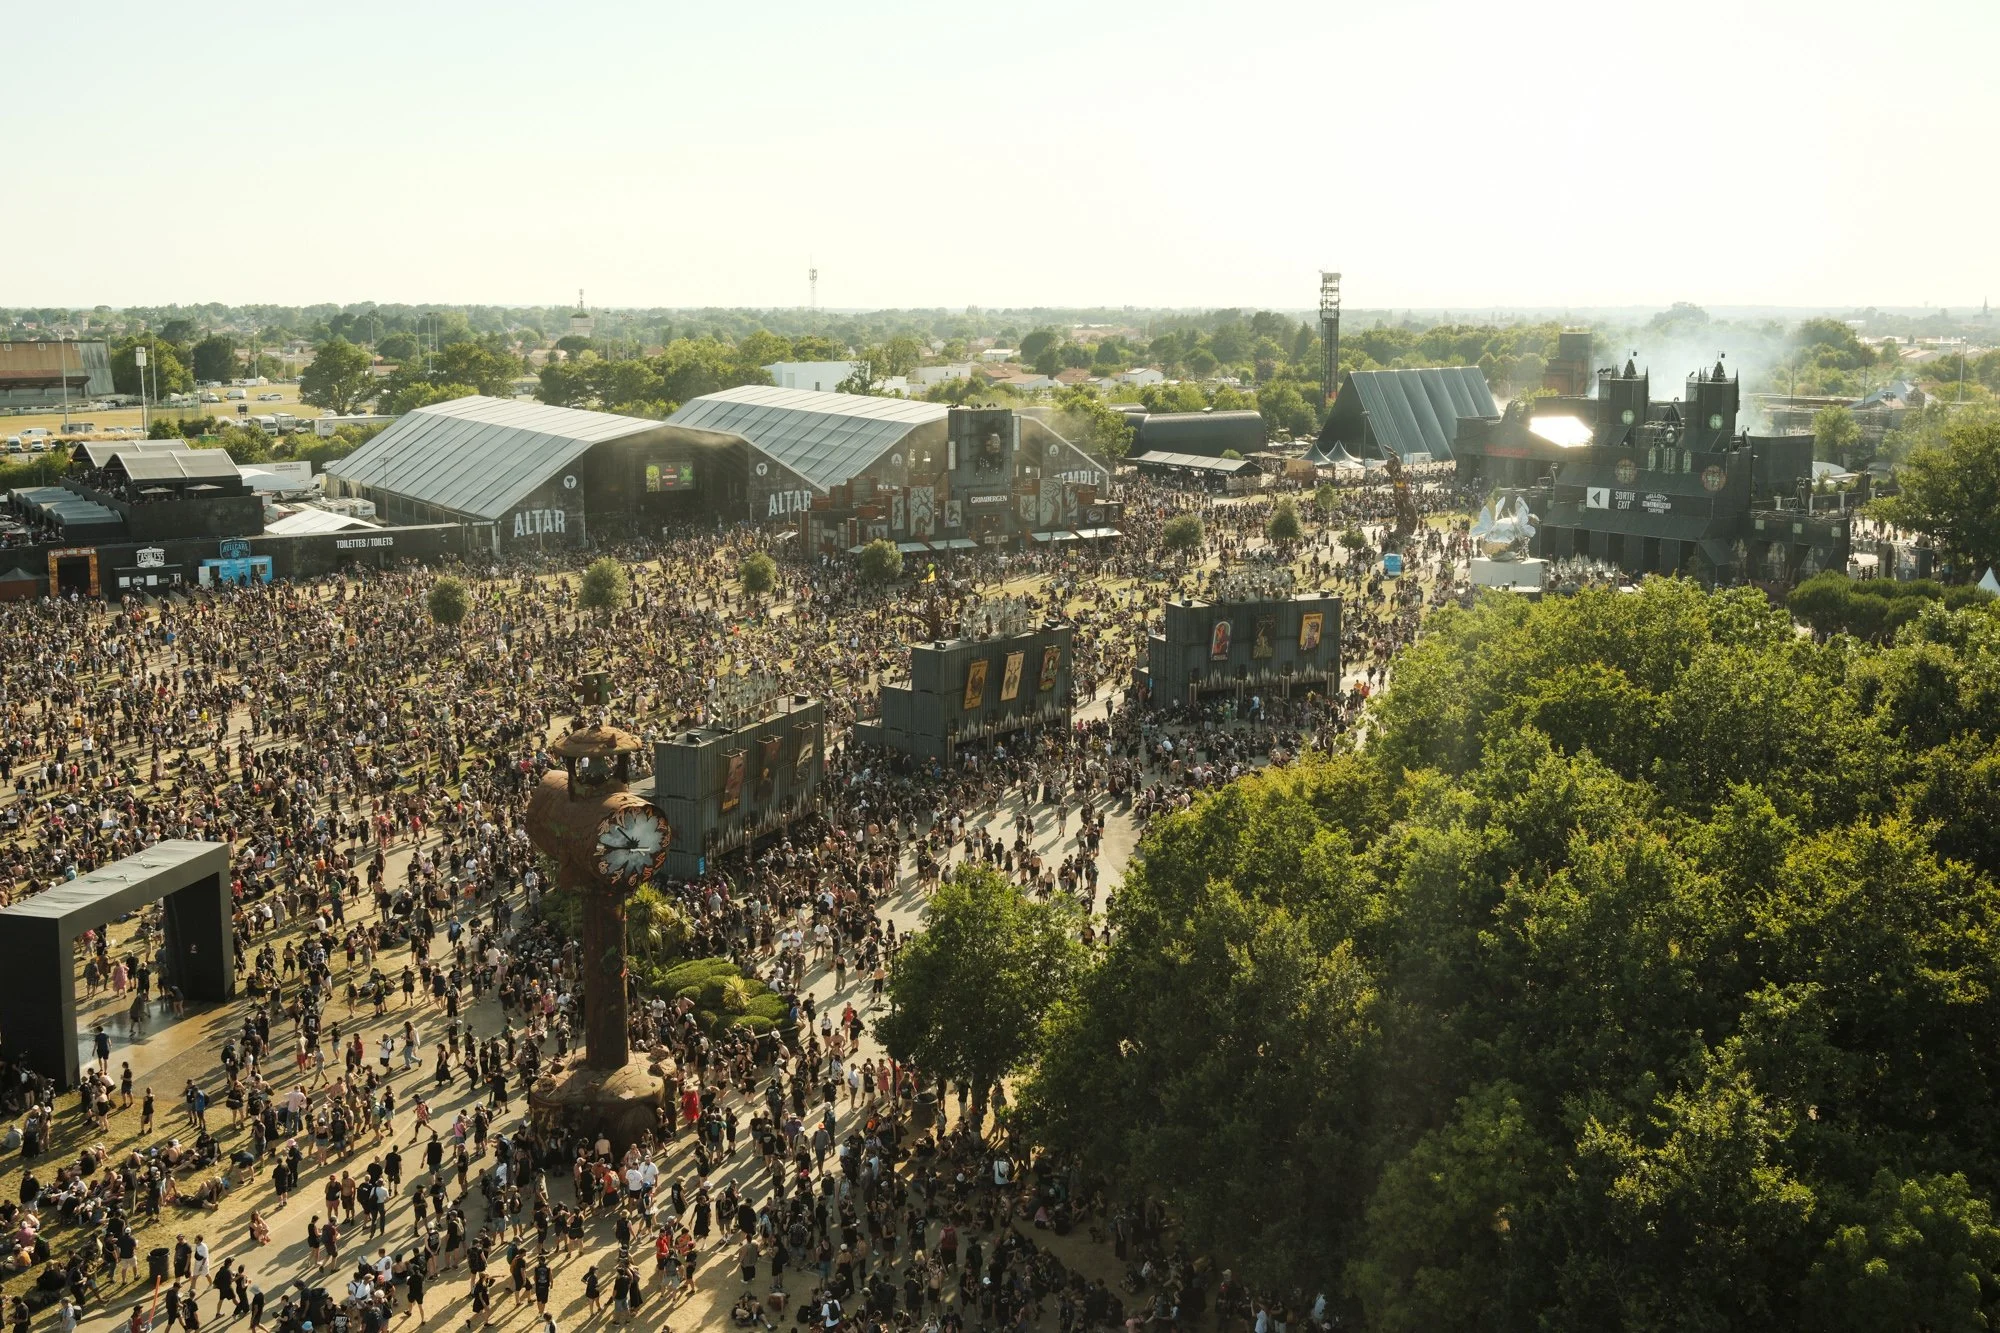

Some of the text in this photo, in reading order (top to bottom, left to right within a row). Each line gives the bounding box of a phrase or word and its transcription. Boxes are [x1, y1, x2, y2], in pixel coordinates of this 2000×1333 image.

[1053, 470, 1101, 485] EMPLE
[970, 495, 1008, 504] GRIMBERGEN
[1615, 491, 1636, 501] SORTIE
[768, 490, 813, 517] ALTAR
[1617, 501, 1631, 510] EXIT
[514, 509, 566, 538] ALTAR
[335, 538, 366, 549] TOILETTES
[370, 536, 394, 547] TOILETS
[136, 552, 165, 564] CASHLESS
